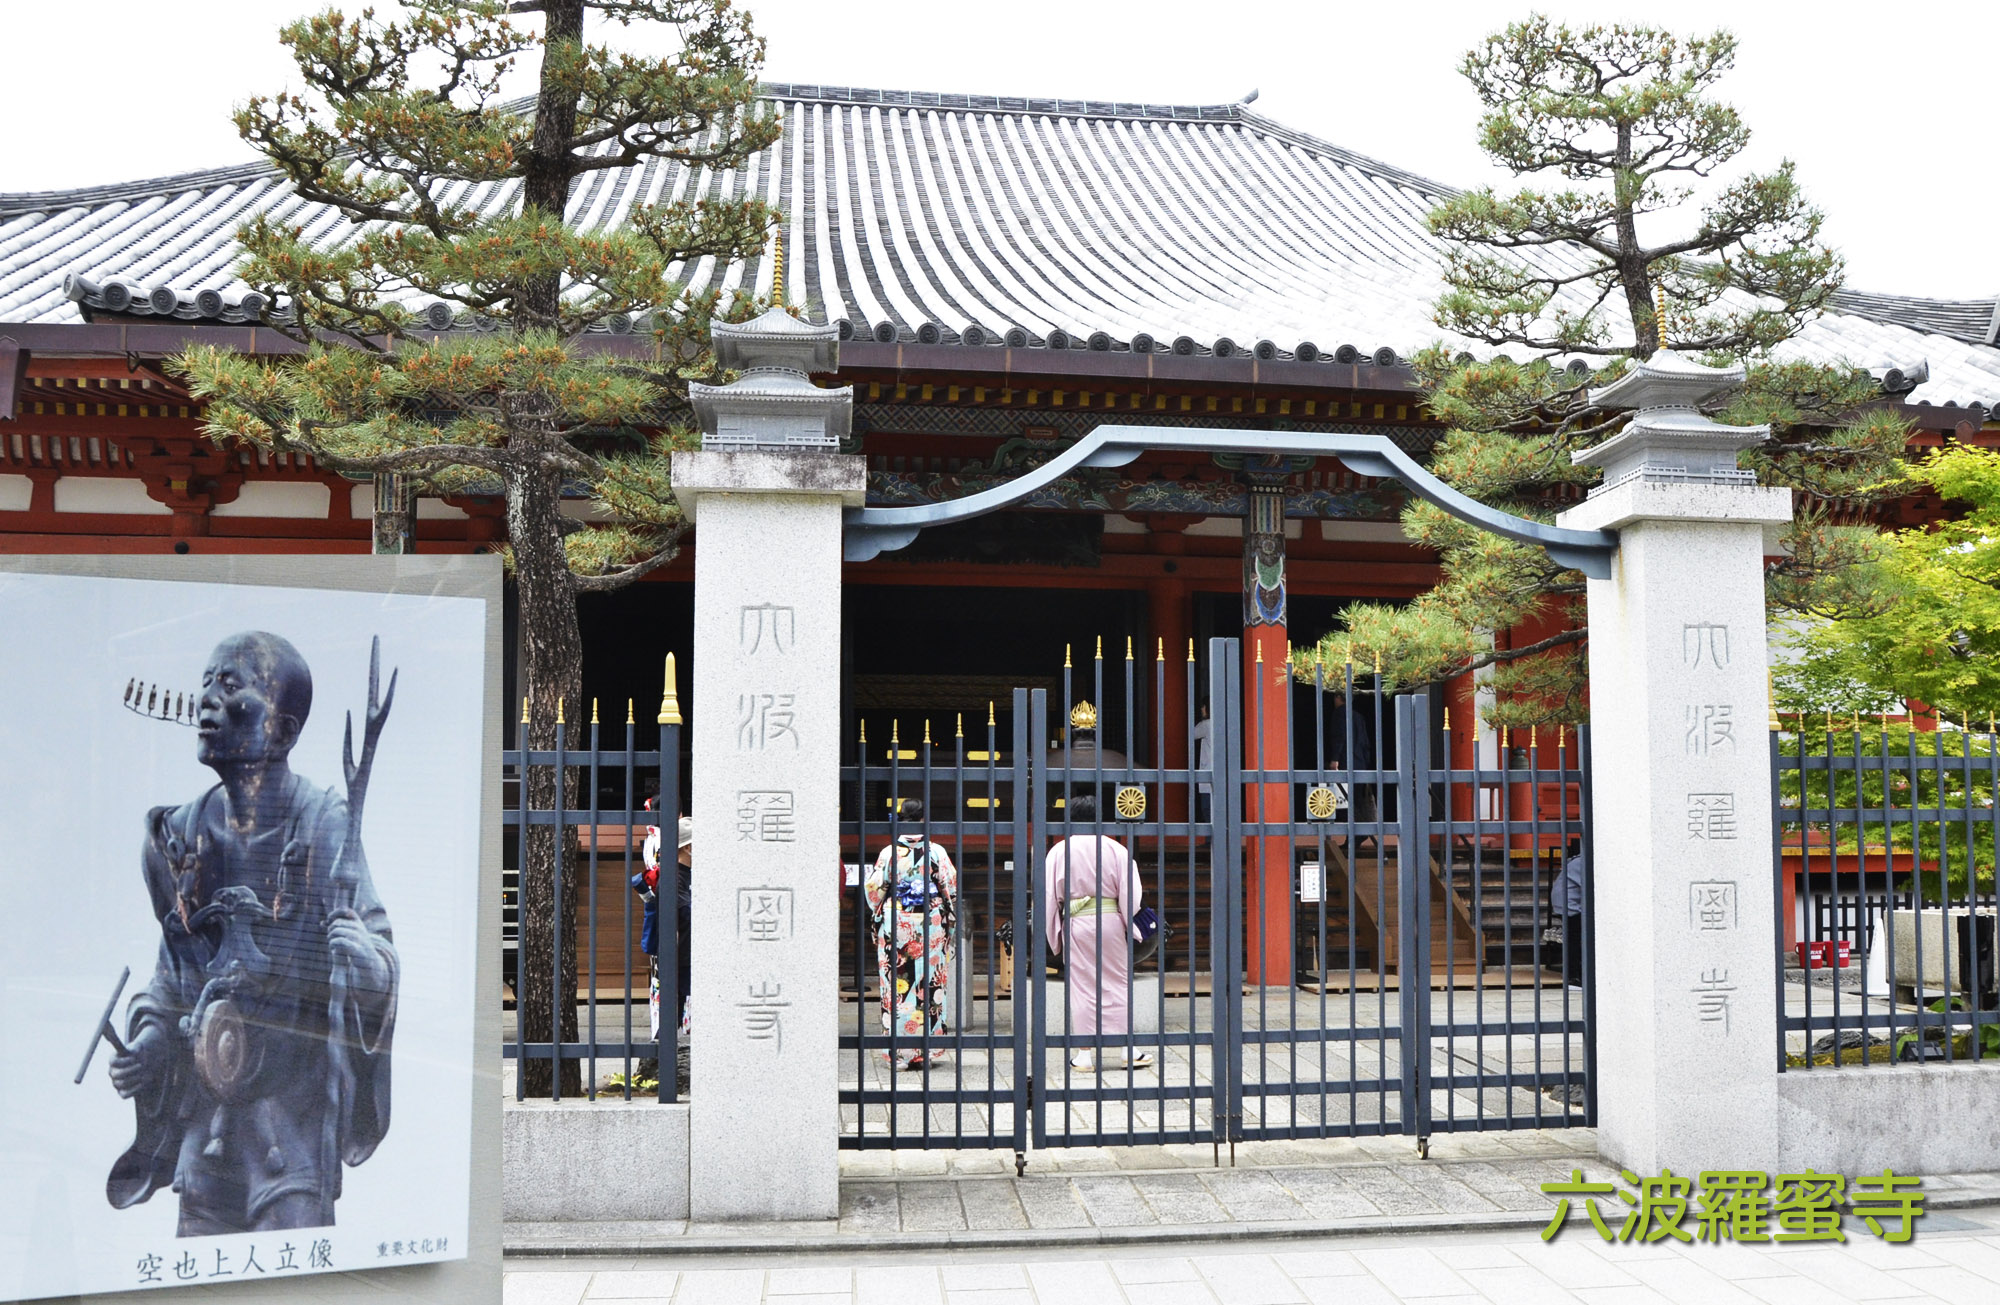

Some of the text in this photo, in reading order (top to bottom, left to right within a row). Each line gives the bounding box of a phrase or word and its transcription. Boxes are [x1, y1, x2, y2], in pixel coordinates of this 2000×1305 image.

[136, 1239, 335, 1284] 空也上人立像
[376, 1236, 448, 1258] 重要文化財
